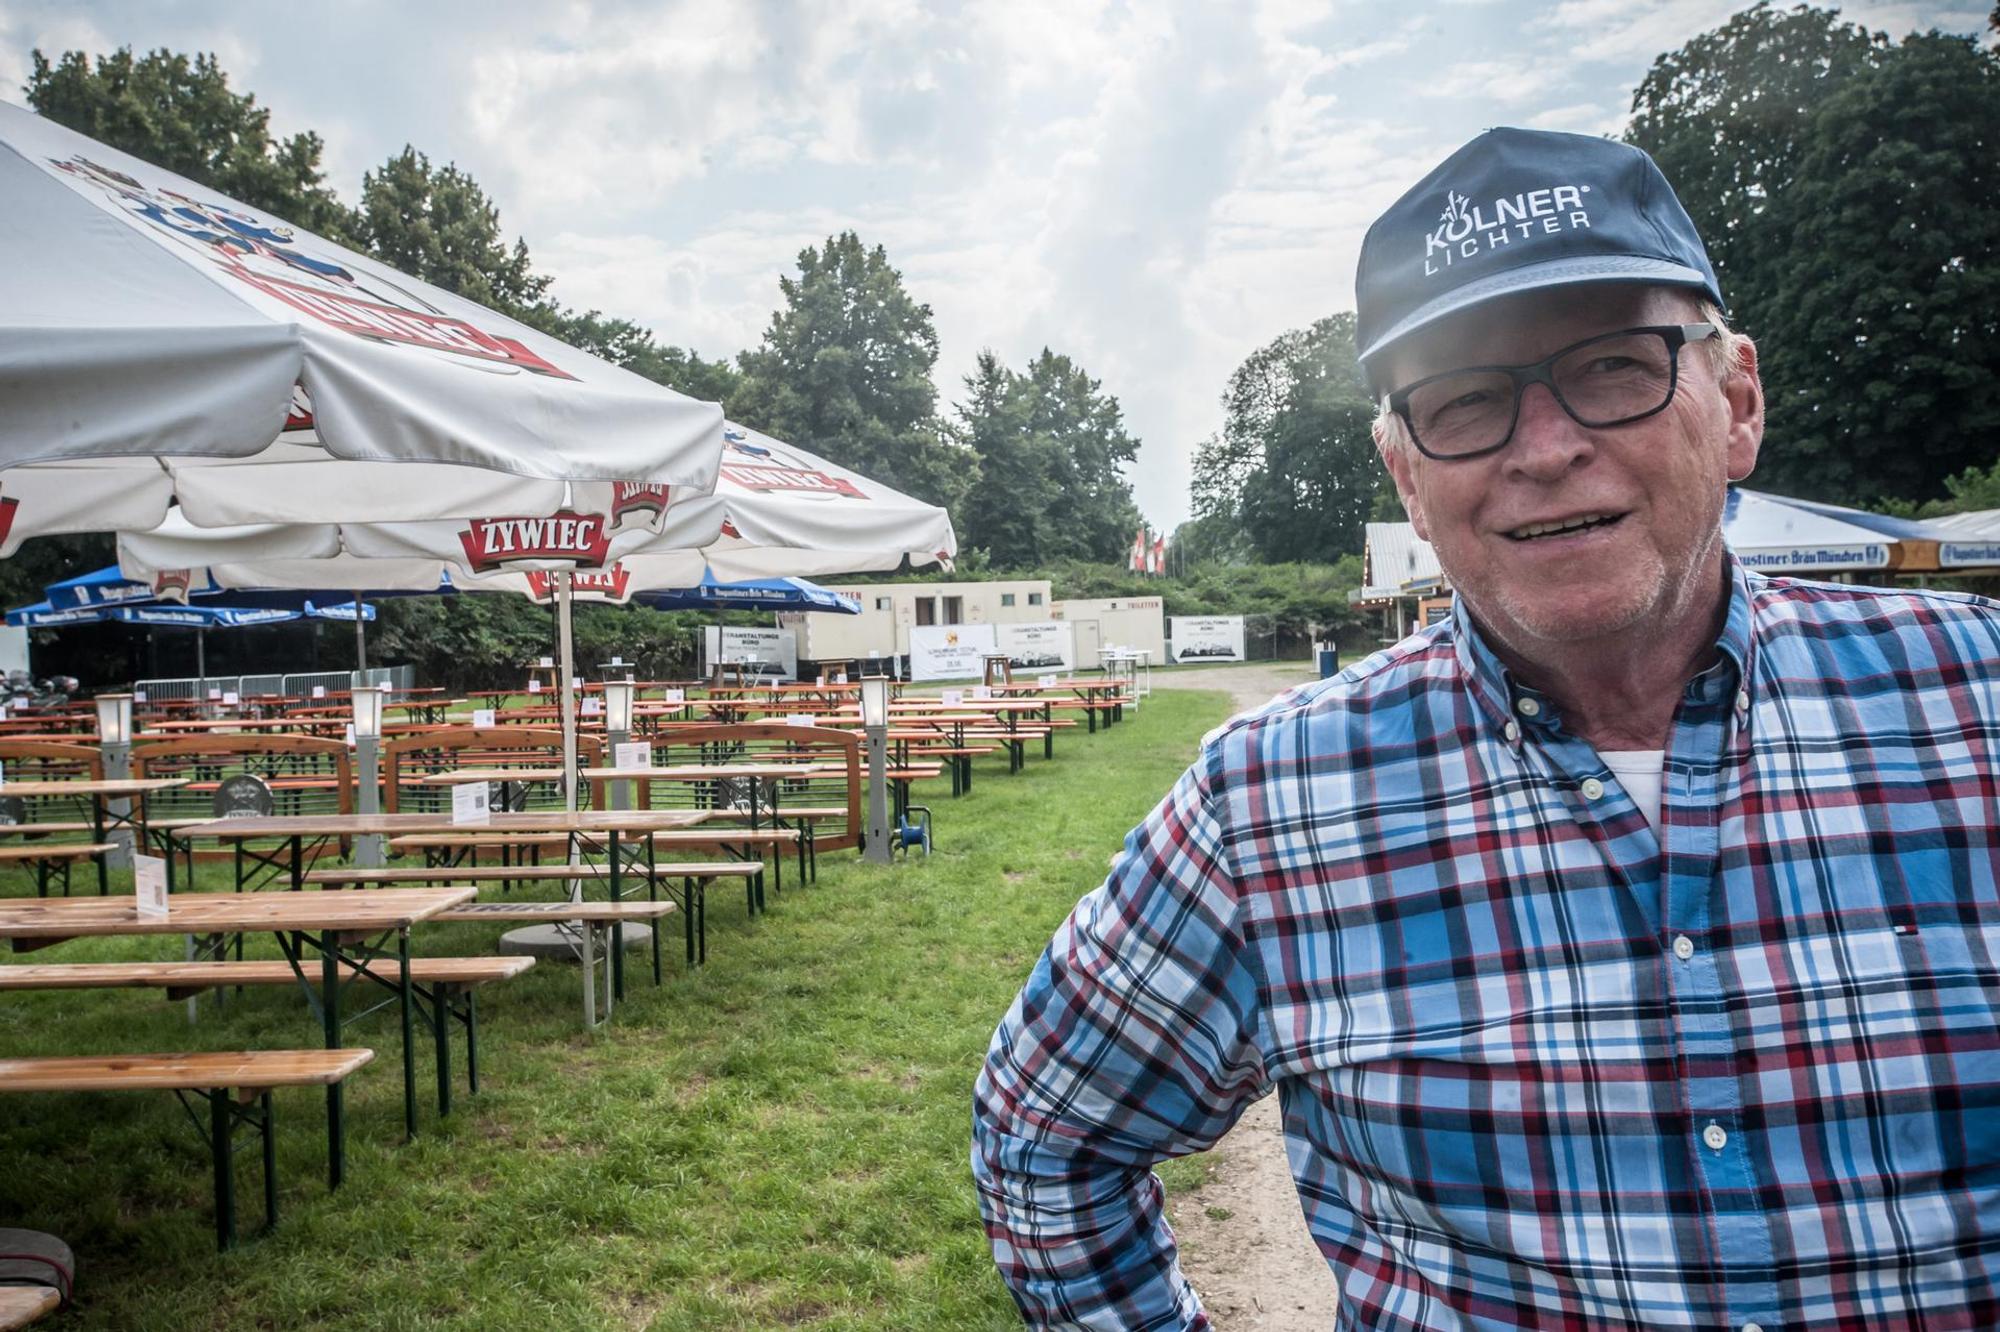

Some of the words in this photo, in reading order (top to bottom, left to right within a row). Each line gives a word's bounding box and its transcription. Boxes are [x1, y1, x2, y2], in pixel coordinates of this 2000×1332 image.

[1424, 211, 1591, 277] LICHTER
[480, 518, 595, 554] ŻYWIEC
[1791, 550, 1815, 565] Bräu
[1817, 550, 1863, 563] München
